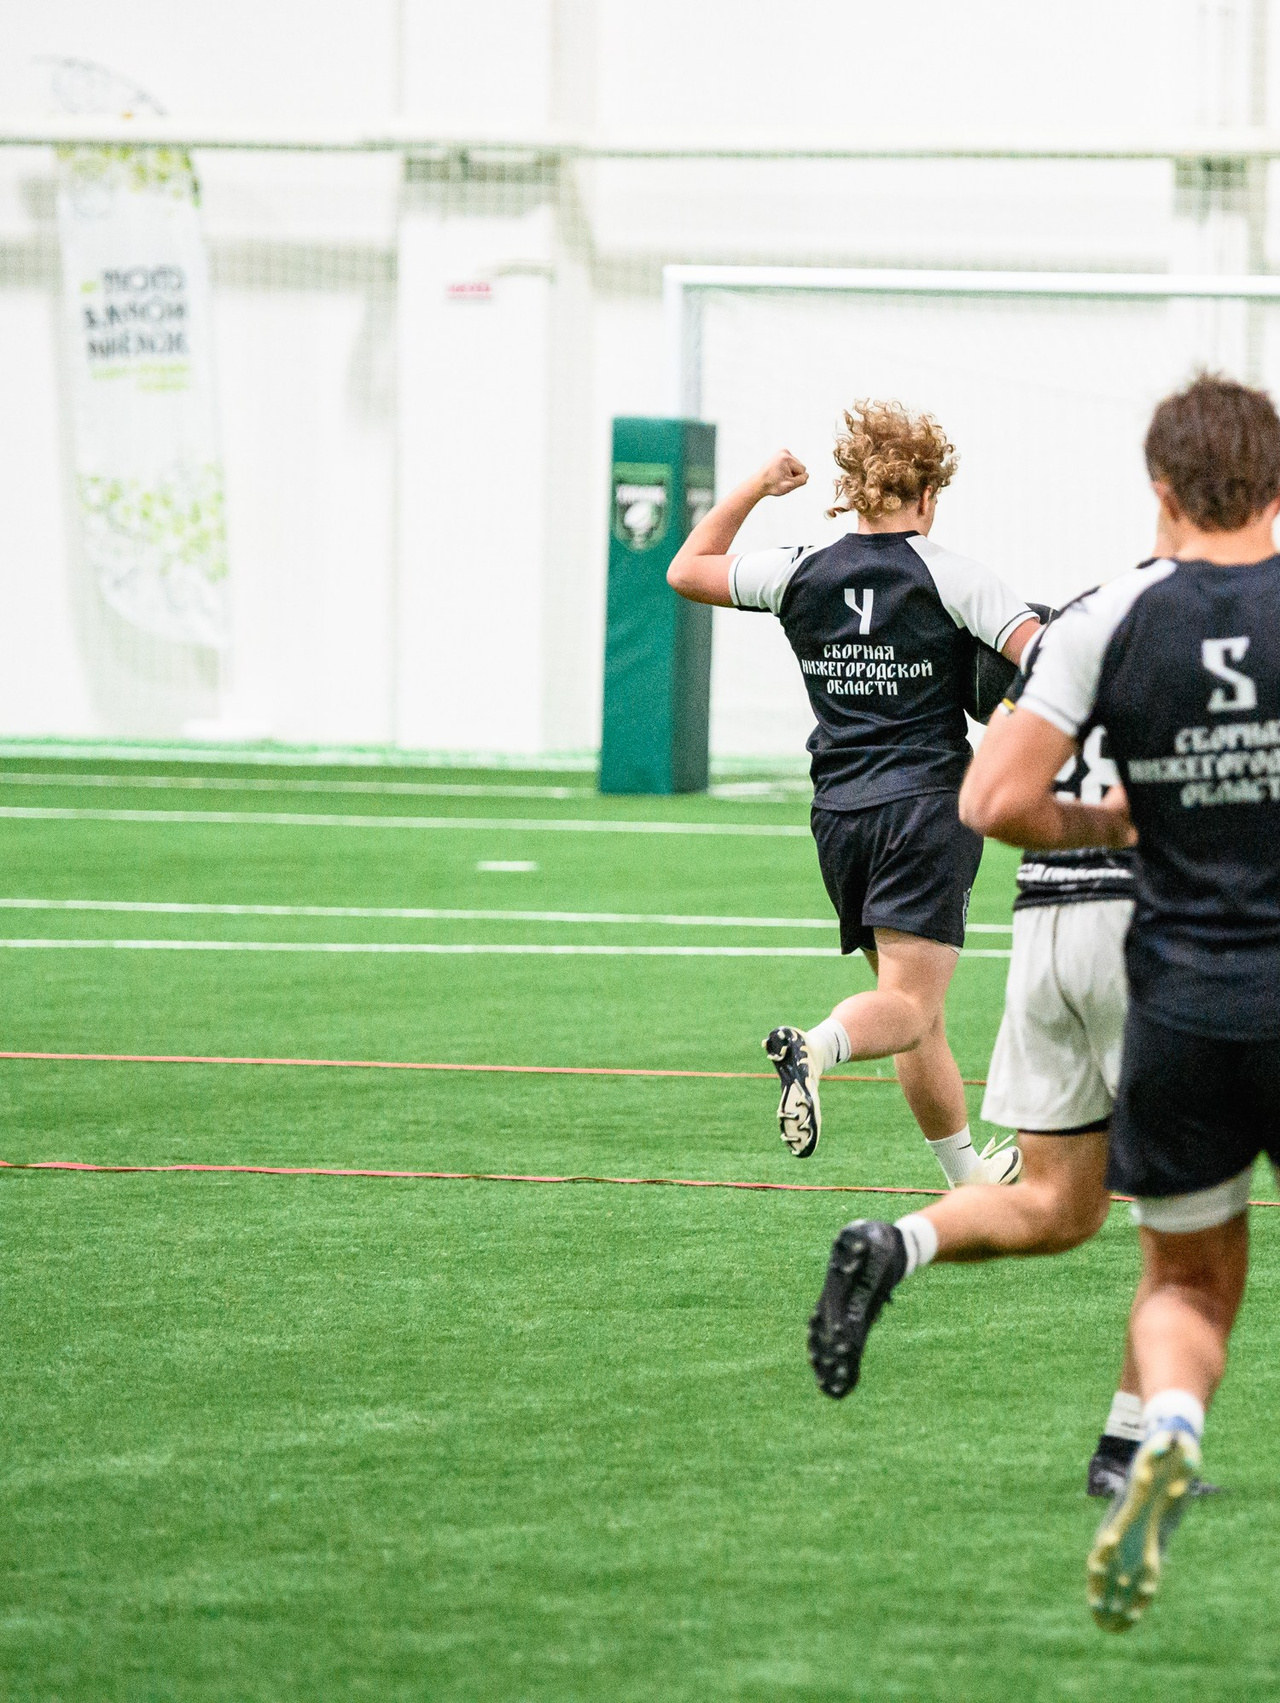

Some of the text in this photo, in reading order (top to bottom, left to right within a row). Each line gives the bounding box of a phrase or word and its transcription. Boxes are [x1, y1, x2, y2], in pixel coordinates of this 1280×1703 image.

[823, 644, 895, 661] СБОРНАЯ
[801, 658, 933, 681] НИЖЕГОРОДСКОЙ
[826, 679, 898, 696] ОБЛАСТИ
